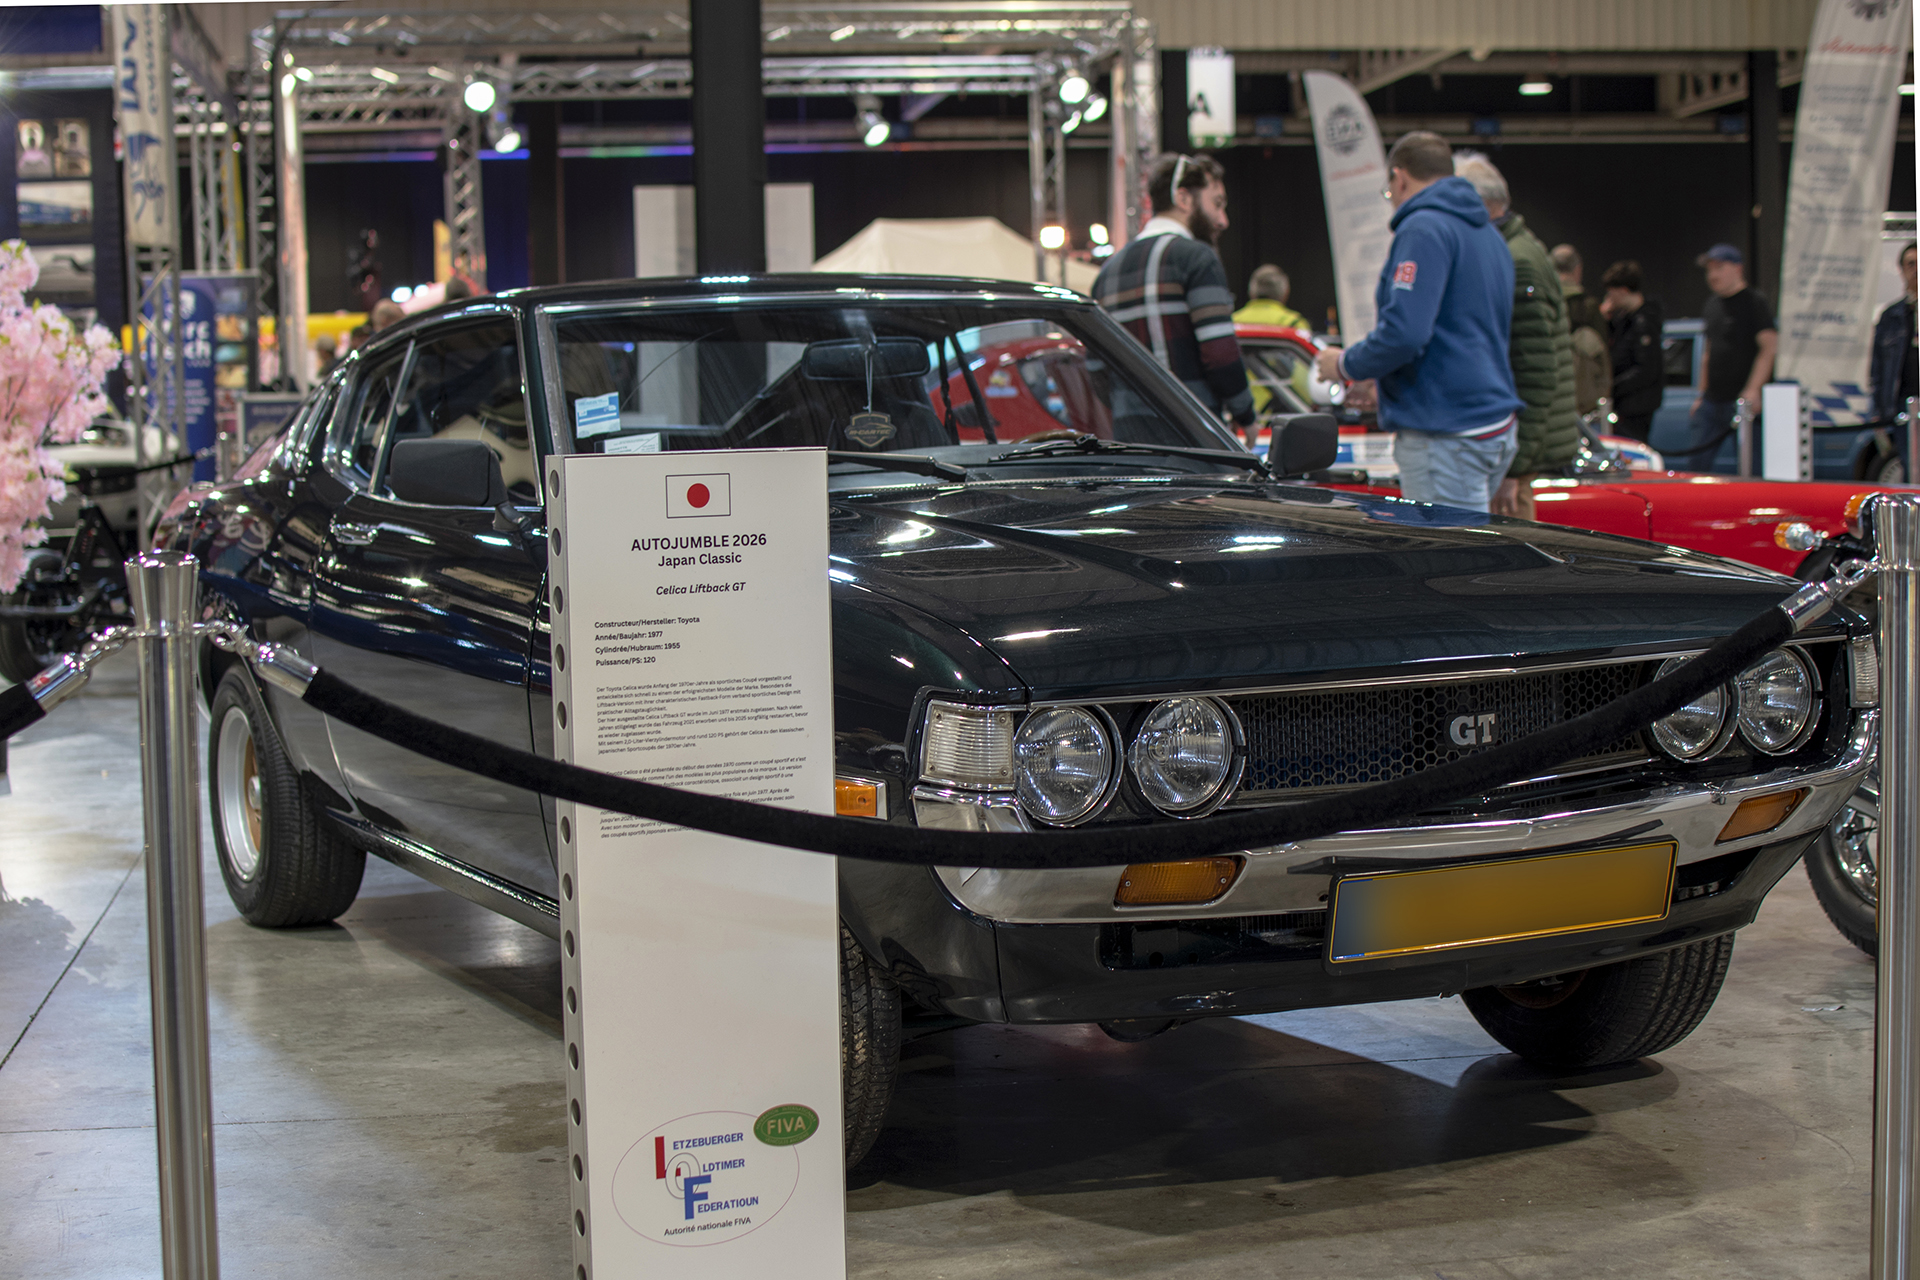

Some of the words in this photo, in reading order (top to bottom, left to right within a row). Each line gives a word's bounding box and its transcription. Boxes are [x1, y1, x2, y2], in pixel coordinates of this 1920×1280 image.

[631, 536, 729, 551] AUTOJUMBLE
[733, 534, 767, 546] 2026
[658, 555, 696, 569] Japan
[699, 552, 742, 565] Classic
[656, 584, 687, 595] Celica
[690, 582, 730, 594] Liftback
[732, 582, 746, 592] GT
[594, 618, 676, 629] Constructeur/Hersteller:
[678, 616, 700, 625] Toyota
[595, 632, 647, 641] Année/Baujahr:
[595, 644, 663, 654] Cylindrée/Hubraum:
[596, 657, 642, 666] Puissance/PS:
[1450, 713, 1495, 746] GT
[767, 1116, 806, 1135] FIVA
[664, 1225, 695, 1236] Autorité
[697, 1220, 732, 1231] nationale
[734, 1217, 751, 1226] FIVA
